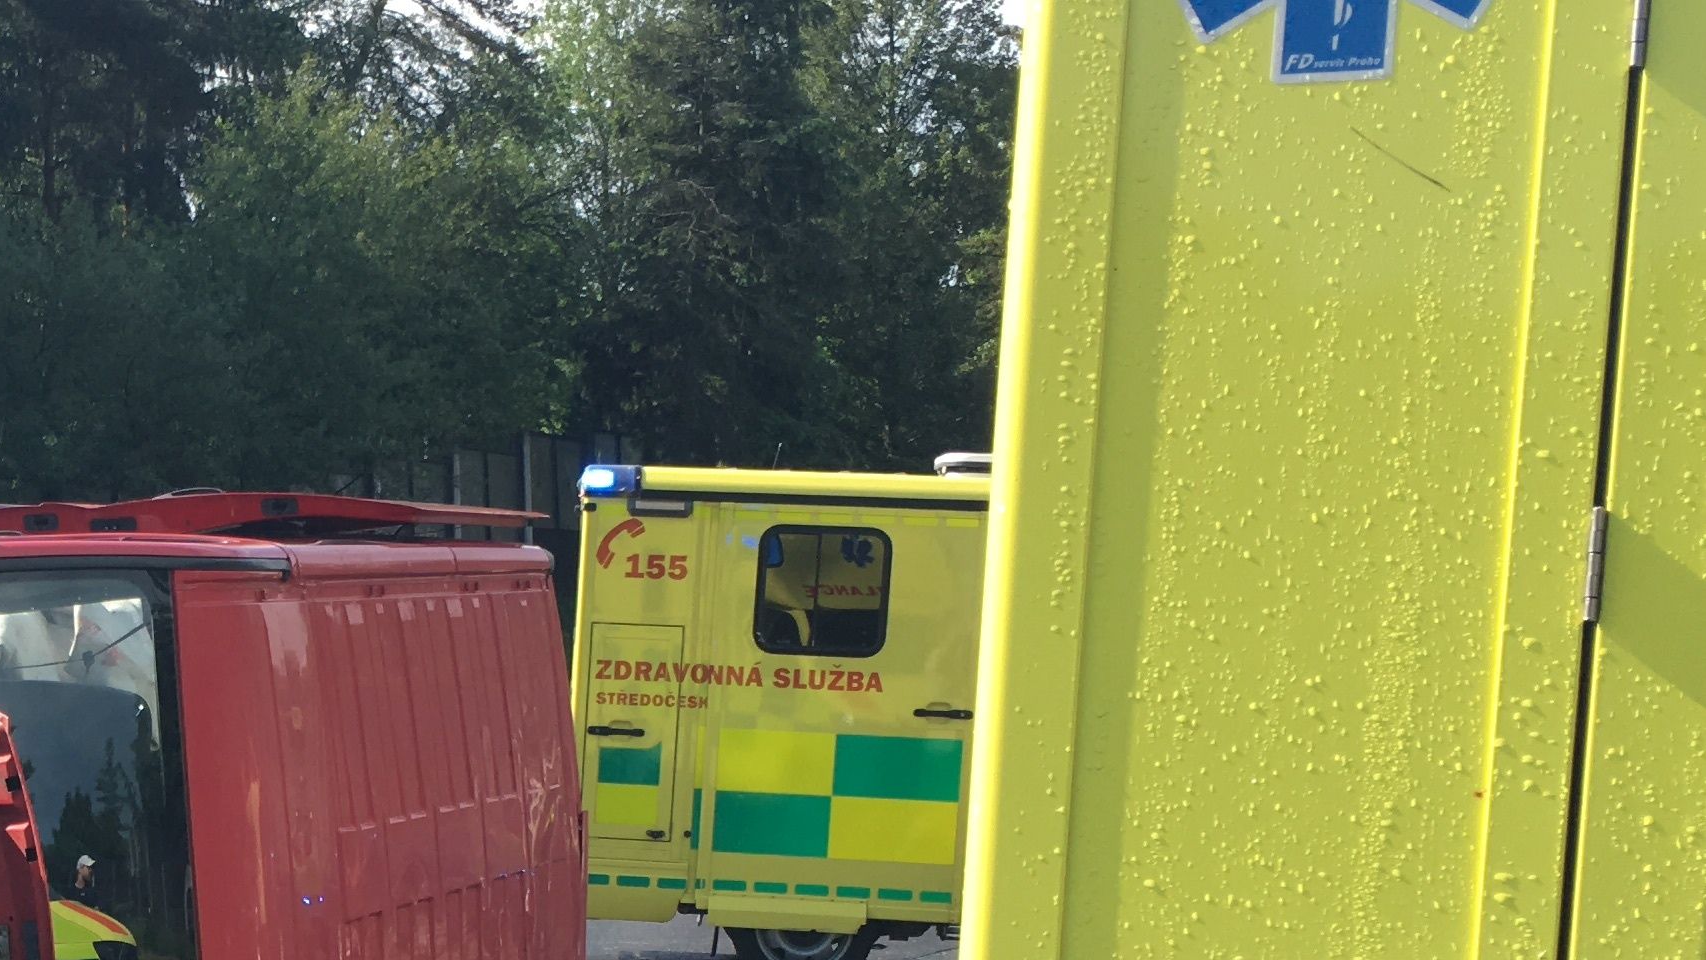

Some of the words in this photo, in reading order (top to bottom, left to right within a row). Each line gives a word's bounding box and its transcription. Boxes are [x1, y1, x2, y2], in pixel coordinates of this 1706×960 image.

[1285, 53, 1314, 72] FD
[624, 553, 688, 580] 155
[773, 664, 883, 692] SLUŽBA
